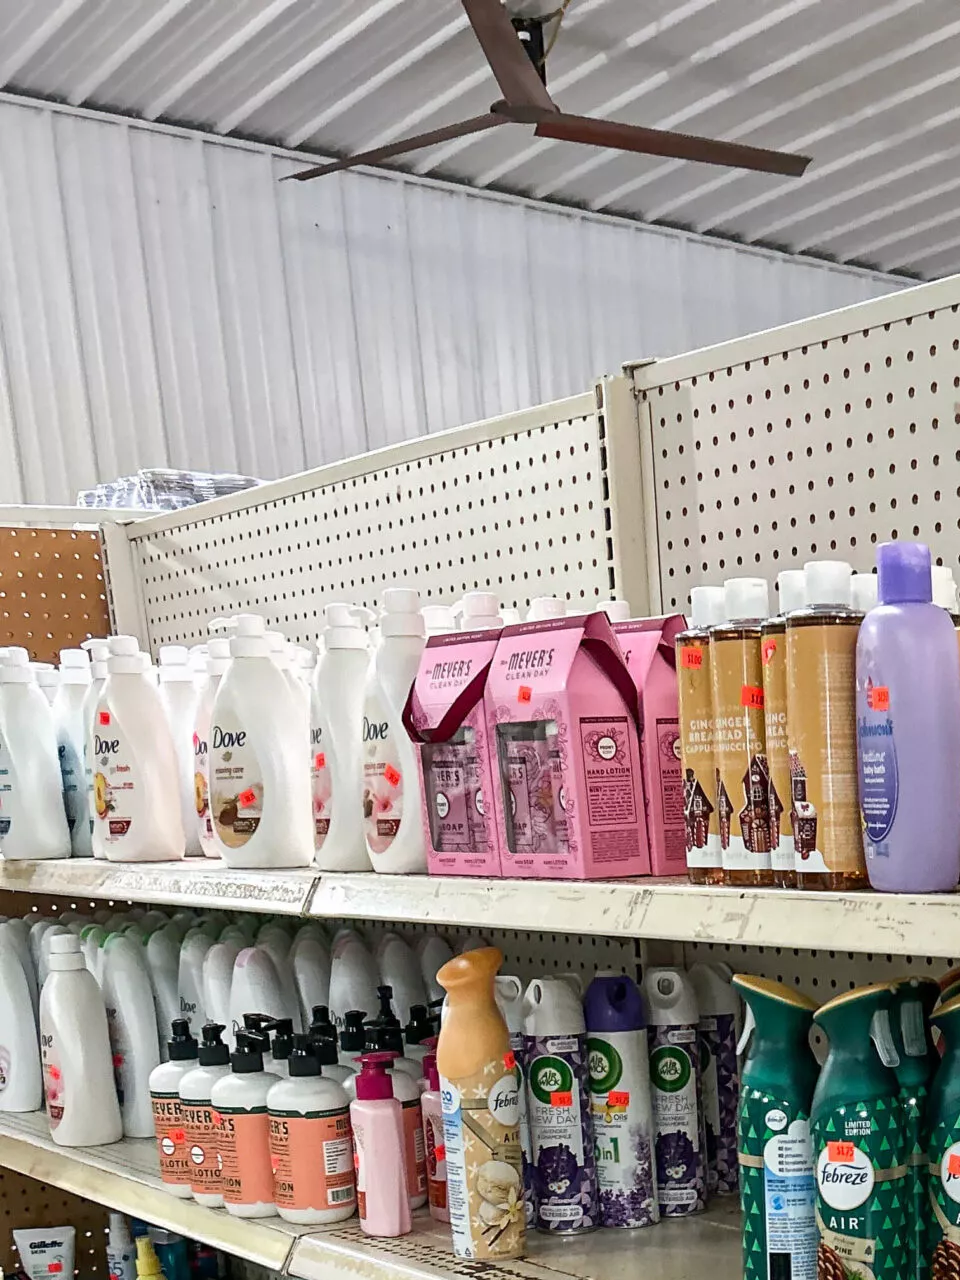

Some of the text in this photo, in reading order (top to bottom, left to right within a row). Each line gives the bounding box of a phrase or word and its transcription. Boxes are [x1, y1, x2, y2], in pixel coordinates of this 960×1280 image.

[505, 668, 550, 681] CLEAN DAY
[362, 716, 389, 742] Dove
[213, 726, 246, 748] Dove
[95, 735, 119, 755] Dove
[180, 997, 196, 1013] Dove
[557, 1114, 577, 1123] DAY
[845, 1121, 870, 1129] LIMITED
[822, 1163, 867, 1185] febreze
[830, 1217, 859, 1229] AIR
[28, 1240, 64, 1250] Gillette
[835, 1246, 852, 1255] PINE
